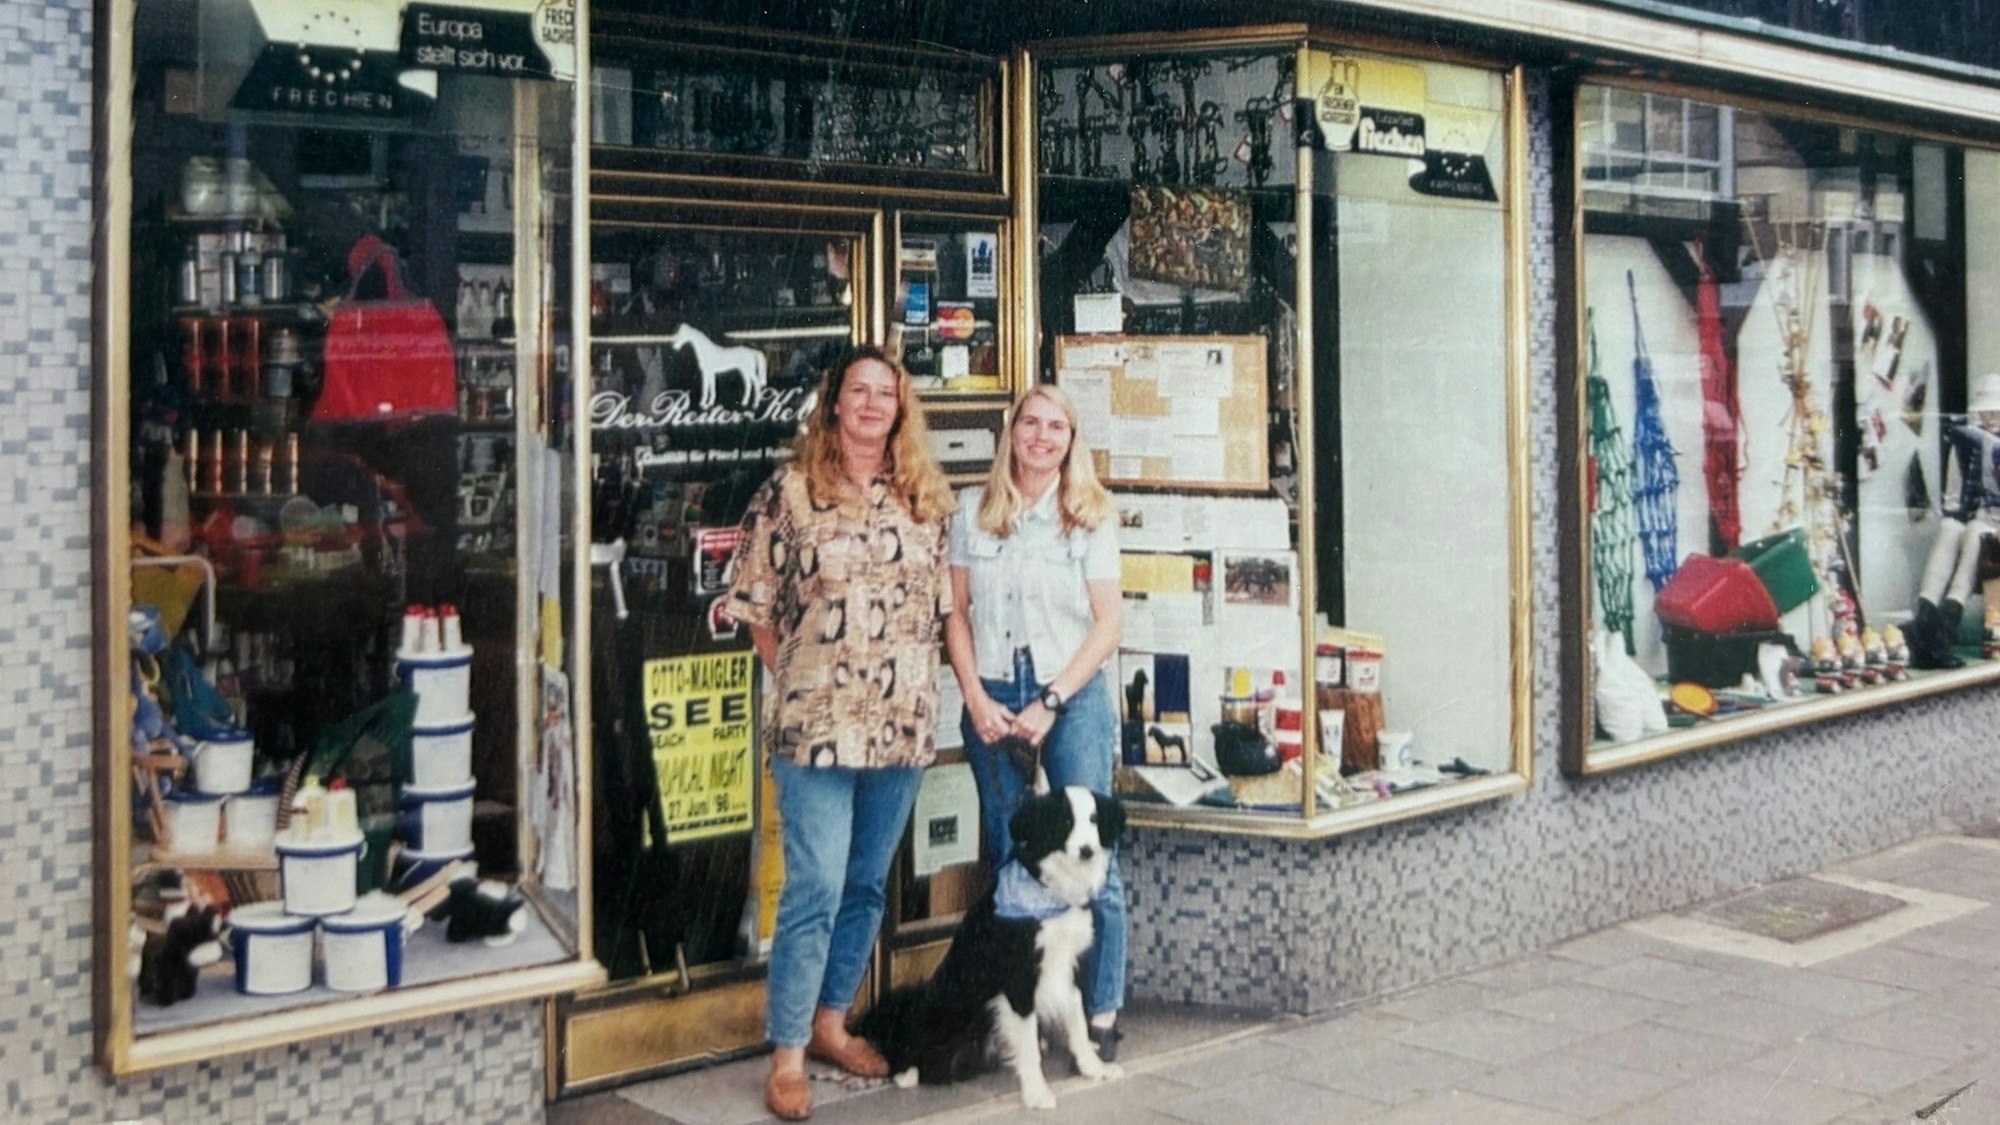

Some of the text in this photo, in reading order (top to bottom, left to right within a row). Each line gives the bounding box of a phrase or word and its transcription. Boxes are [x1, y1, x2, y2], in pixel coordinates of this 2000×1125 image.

[418, 13, 483, 41] Europa
[416, 45, 455, 65] stellt
[459, 51, 496, 69] sich
[272, 86, 393, 110] FRECHEN
[590, 390, 653, 429] Der
[650, 692, 747, 731] SEE
